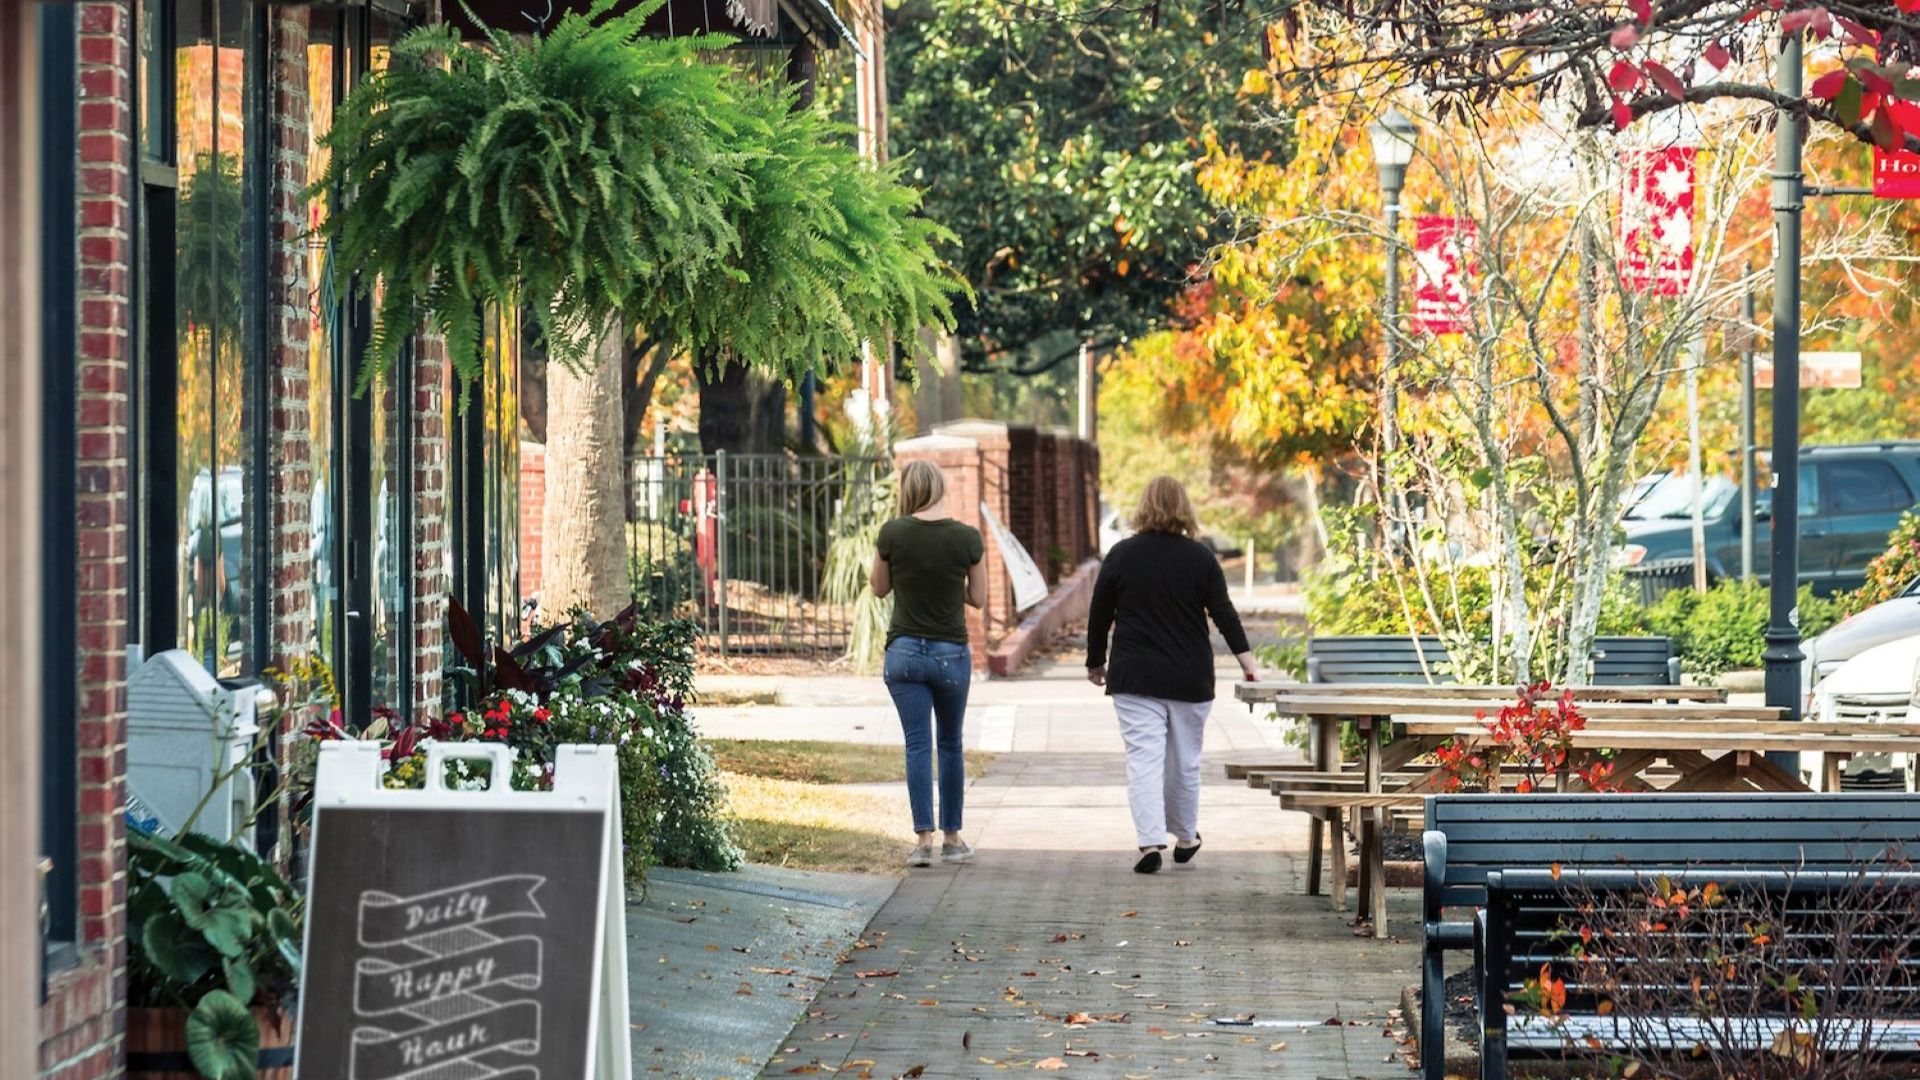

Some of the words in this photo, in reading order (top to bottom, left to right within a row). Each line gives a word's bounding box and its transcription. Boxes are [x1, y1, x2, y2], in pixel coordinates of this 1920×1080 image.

[405, 891, 488, 931] Daily
[390, 957, 495, 999] Happy
[400, 1023, 488, 1065] Hour
